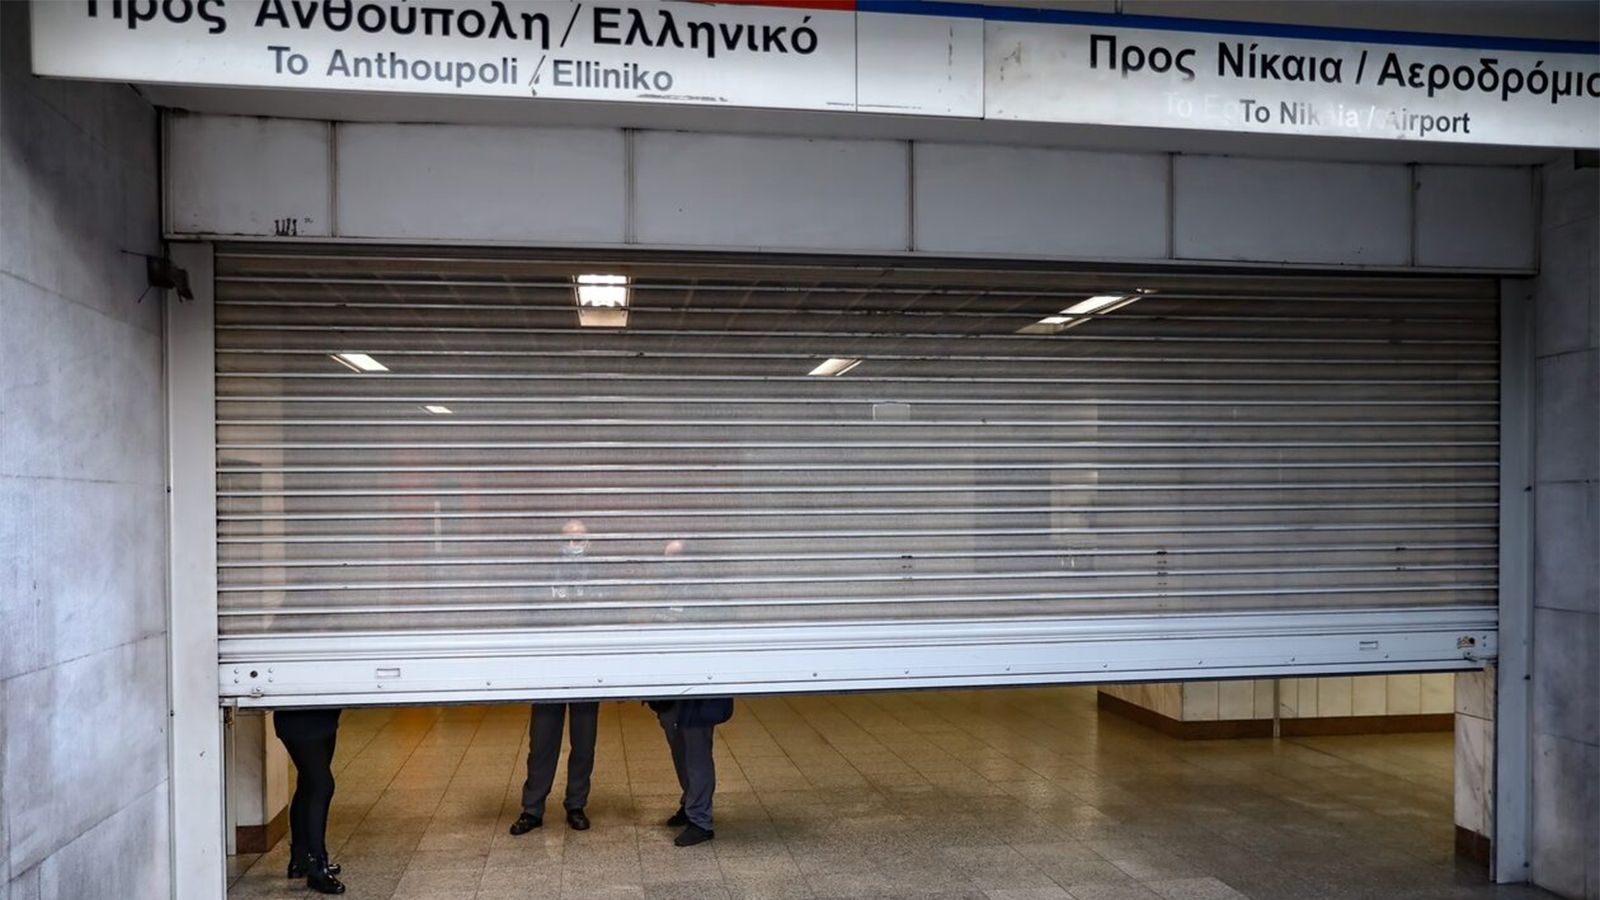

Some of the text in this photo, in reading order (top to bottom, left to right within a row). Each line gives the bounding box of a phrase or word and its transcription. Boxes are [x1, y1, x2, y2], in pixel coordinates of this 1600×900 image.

[255, 0, 550, 50] Ανθούπολη
[560, 3, 582, 48] /
[593, 7, 818, 58] Ελληνικό
[267, 45, 309, 75] To
[326, 49, 518, 88] Anthoupoli
[553, 59, 674, 92] Elliniko
[1090, 34, 1196, 82] Προς
[1218, 41, 1343, 83] Νίκαια
[1355, 50, 1368, 84] /
[1239, 98, 1271, 124] To
